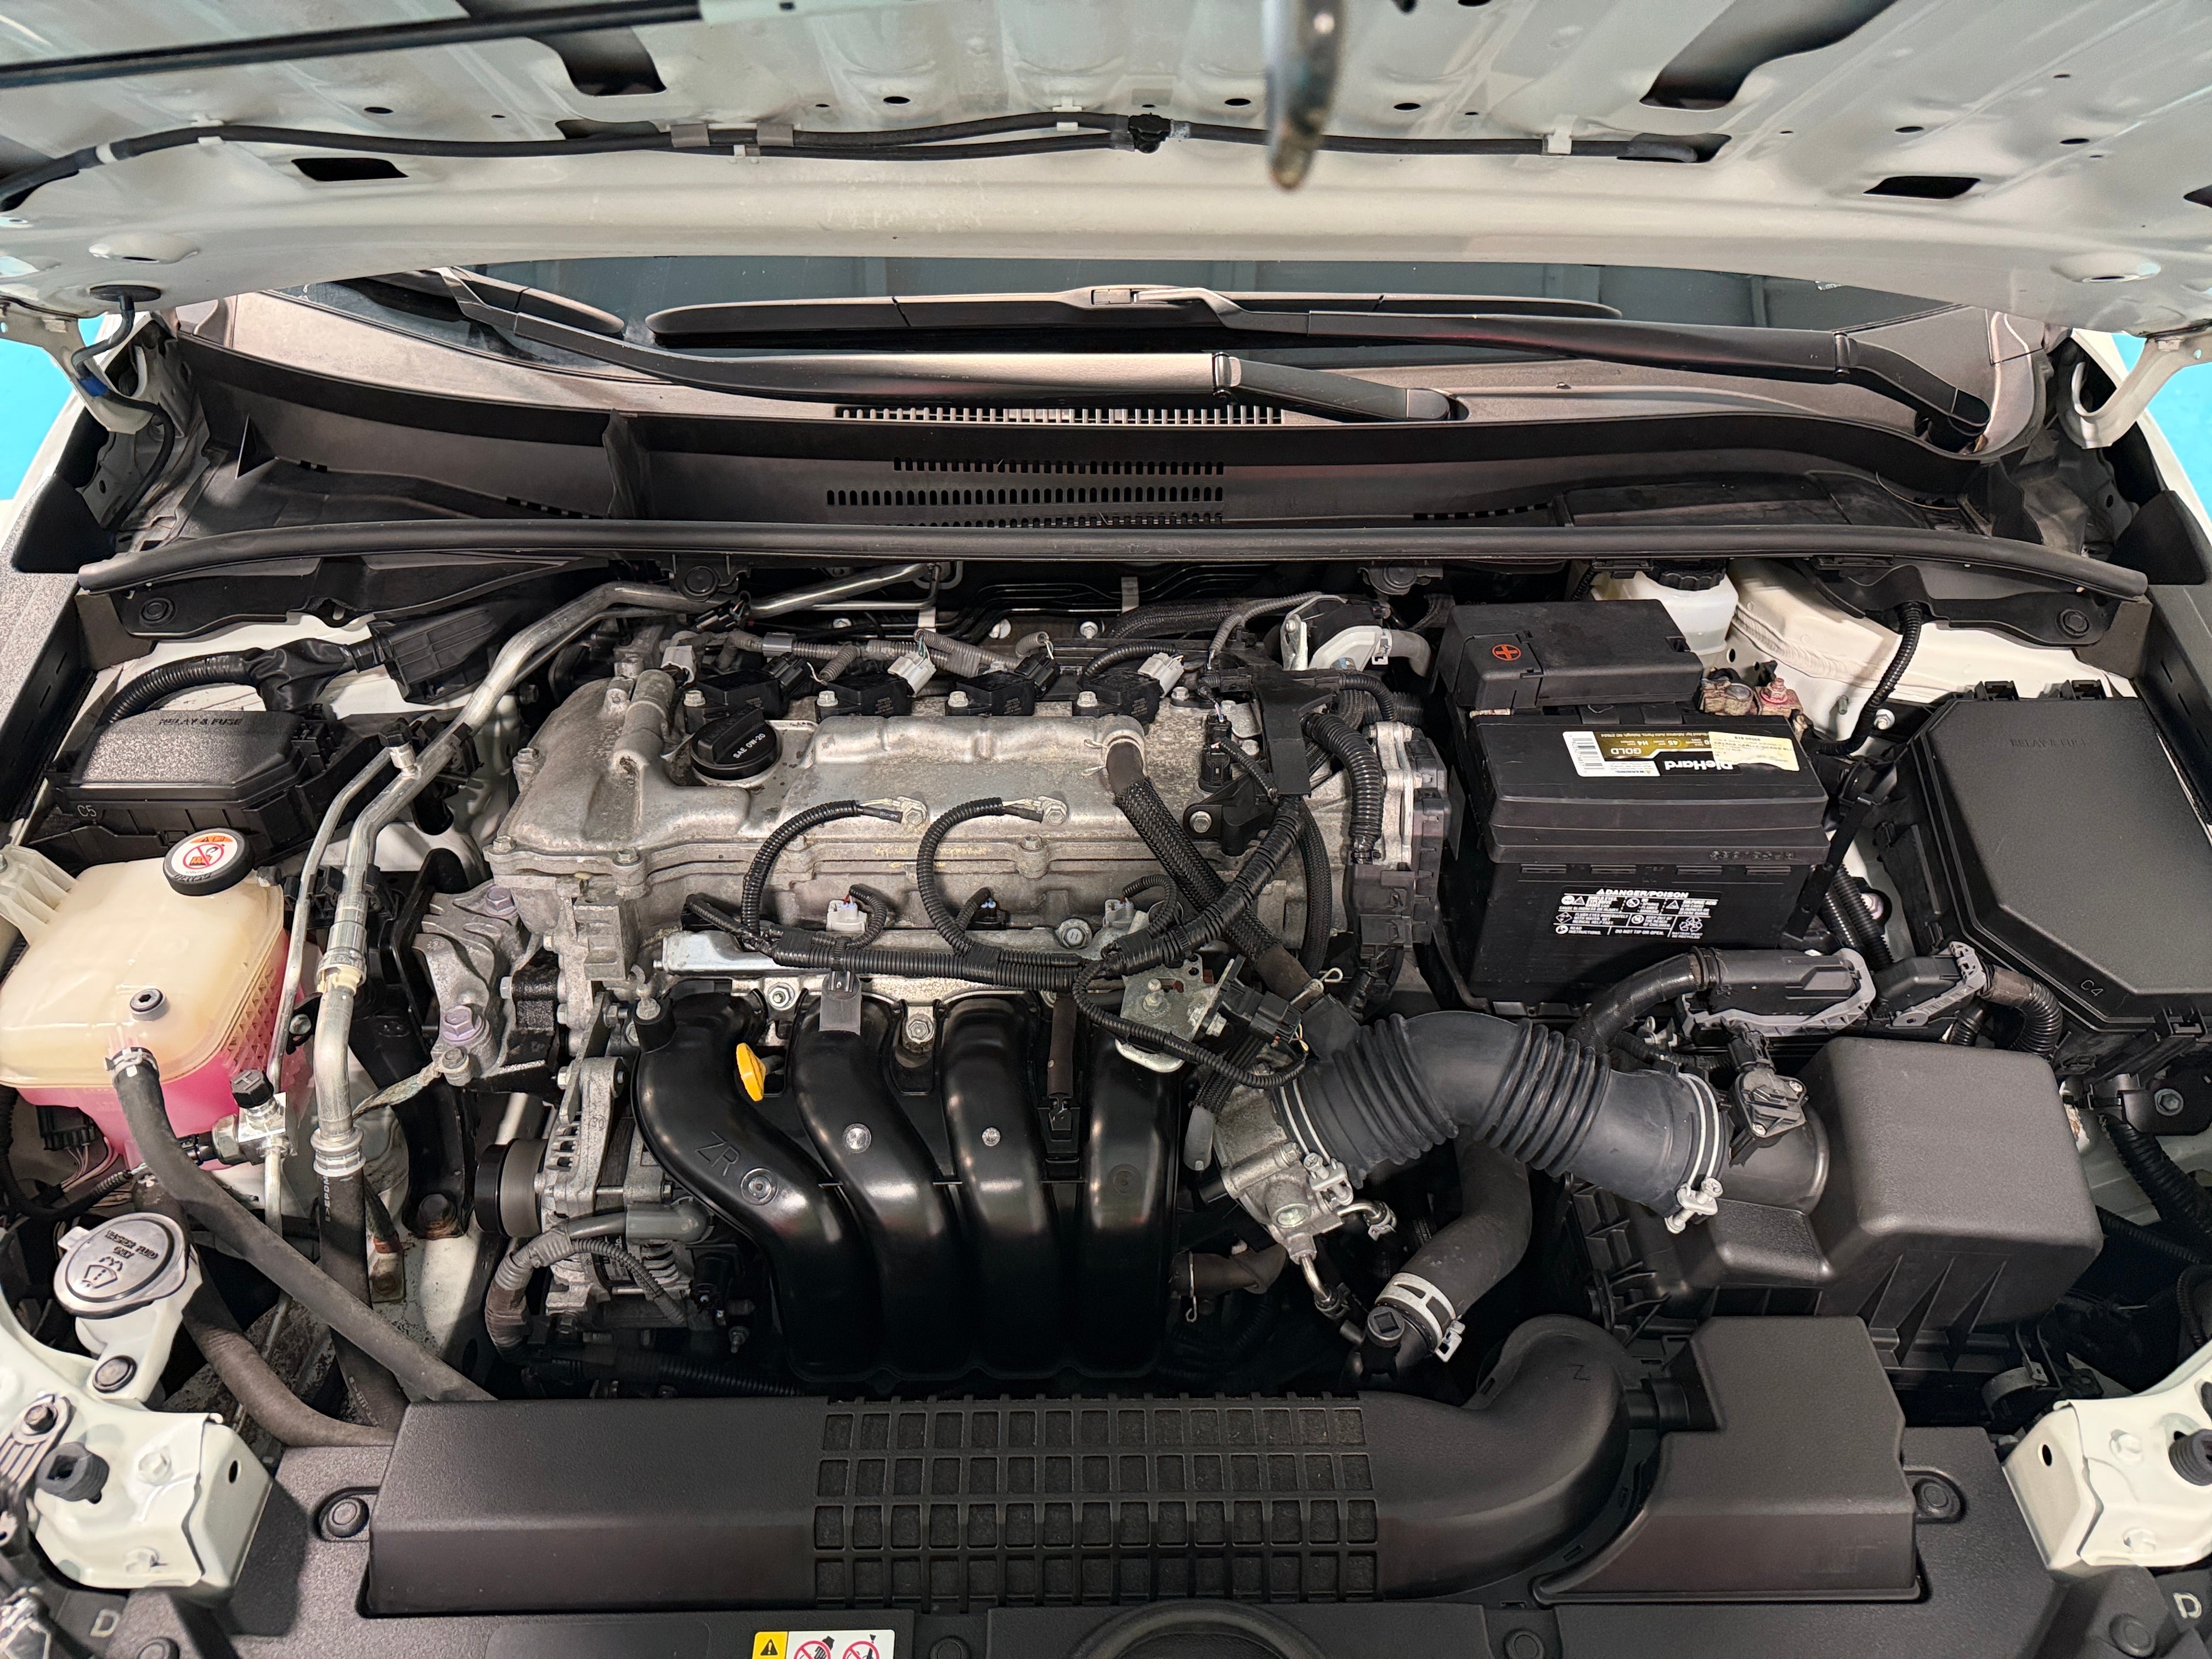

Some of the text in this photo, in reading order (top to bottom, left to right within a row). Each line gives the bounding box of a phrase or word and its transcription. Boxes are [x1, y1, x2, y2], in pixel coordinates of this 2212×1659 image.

[732, 732, 767, 759] SAE 0W-20
[1664, 760, 1734, 771] DieHard
[76, 804, 98, 818] C5
[1605, 888, 1690, 898] DANGER/POISON
[2080, 979, 2104, 997] C4
[234, 1070, 261, 1091] H
[694, 1130, 741, 1177] ZR
[2172, 1592, 2202, 1620] D
[90, 1608, 120, 1638] D
